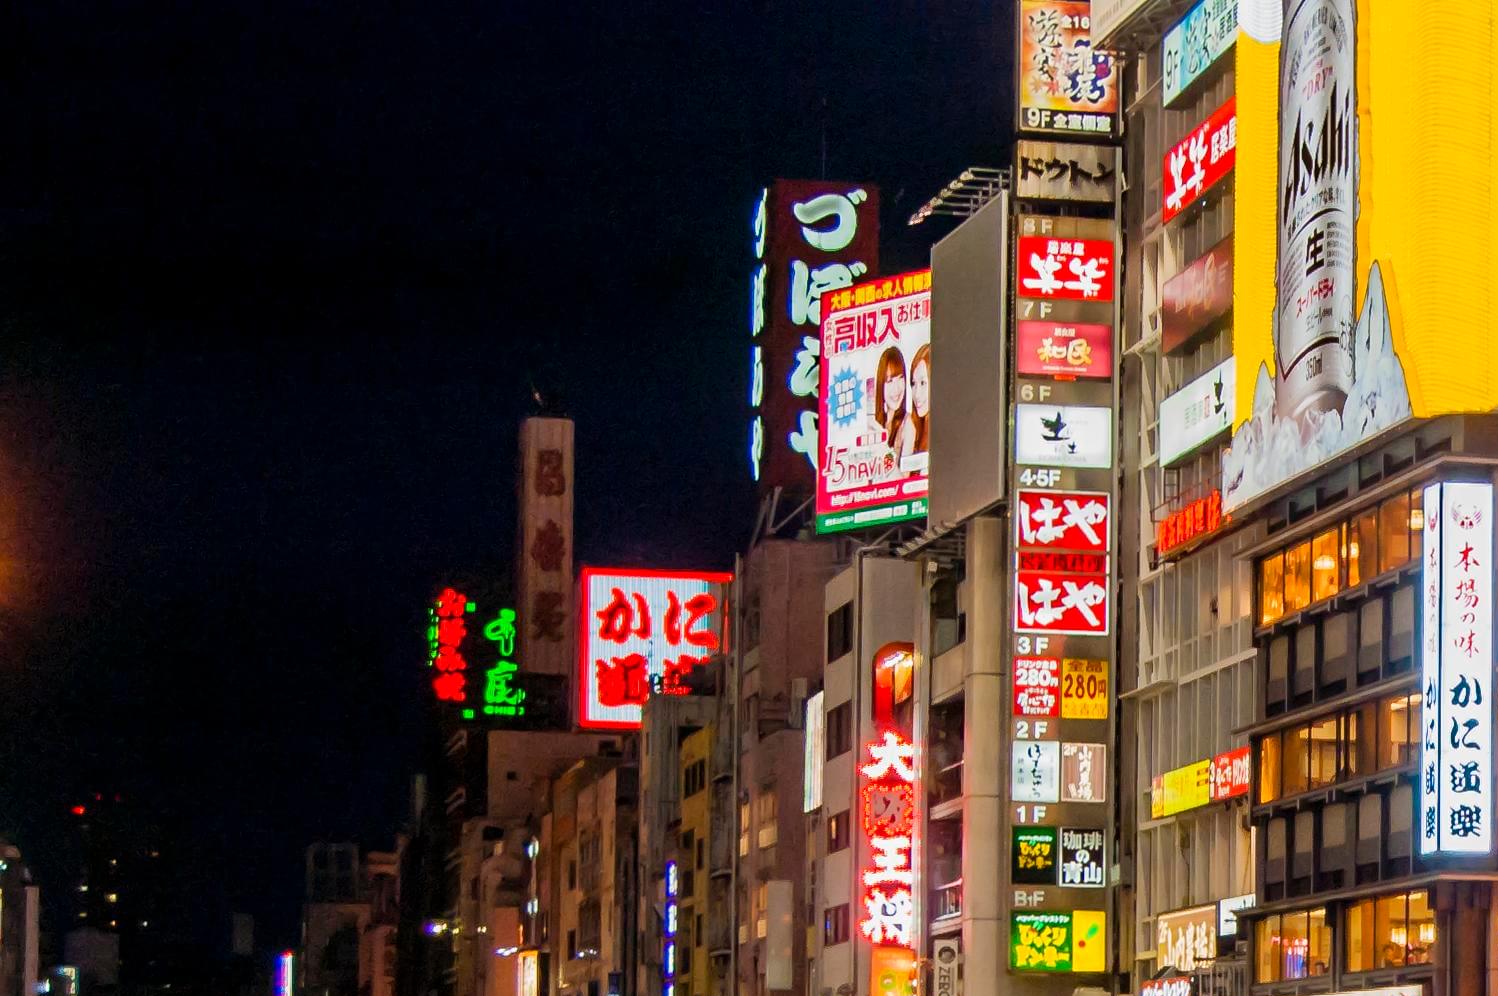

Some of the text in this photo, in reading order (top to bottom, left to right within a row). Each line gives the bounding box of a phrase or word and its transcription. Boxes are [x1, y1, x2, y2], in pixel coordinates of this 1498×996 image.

[1283, 79, 1351, 227] Asahi
[1305, 226, 1325, 277] 生
[833, 305, 900, 356] 高収入
[1021, 385, 1051, 402] 6F
[1020, 497, 1107, 546] はや
[1019, 578, 1106, 627] はや
[1444, 541, 1482, 658] 本場の味
[596, 587, 721, 645] かに
[1017, 636, 1049, 656] 3F
[1063, 673, 1107, 700] 280円
[1016, 721, 1048, 740] 2F
[1016, 805, 1047, 824] 1F
[1063, 831, 1102, 850] 珈琲
[1075, 849, 1090, 864] の
[1063, 862, 1102, 884] 青山
[1014, 890, 1045, 907] B1F
[1017, 924, 1067, 947] びっくり
[1015, 944, 1070, 968] ドンキー
